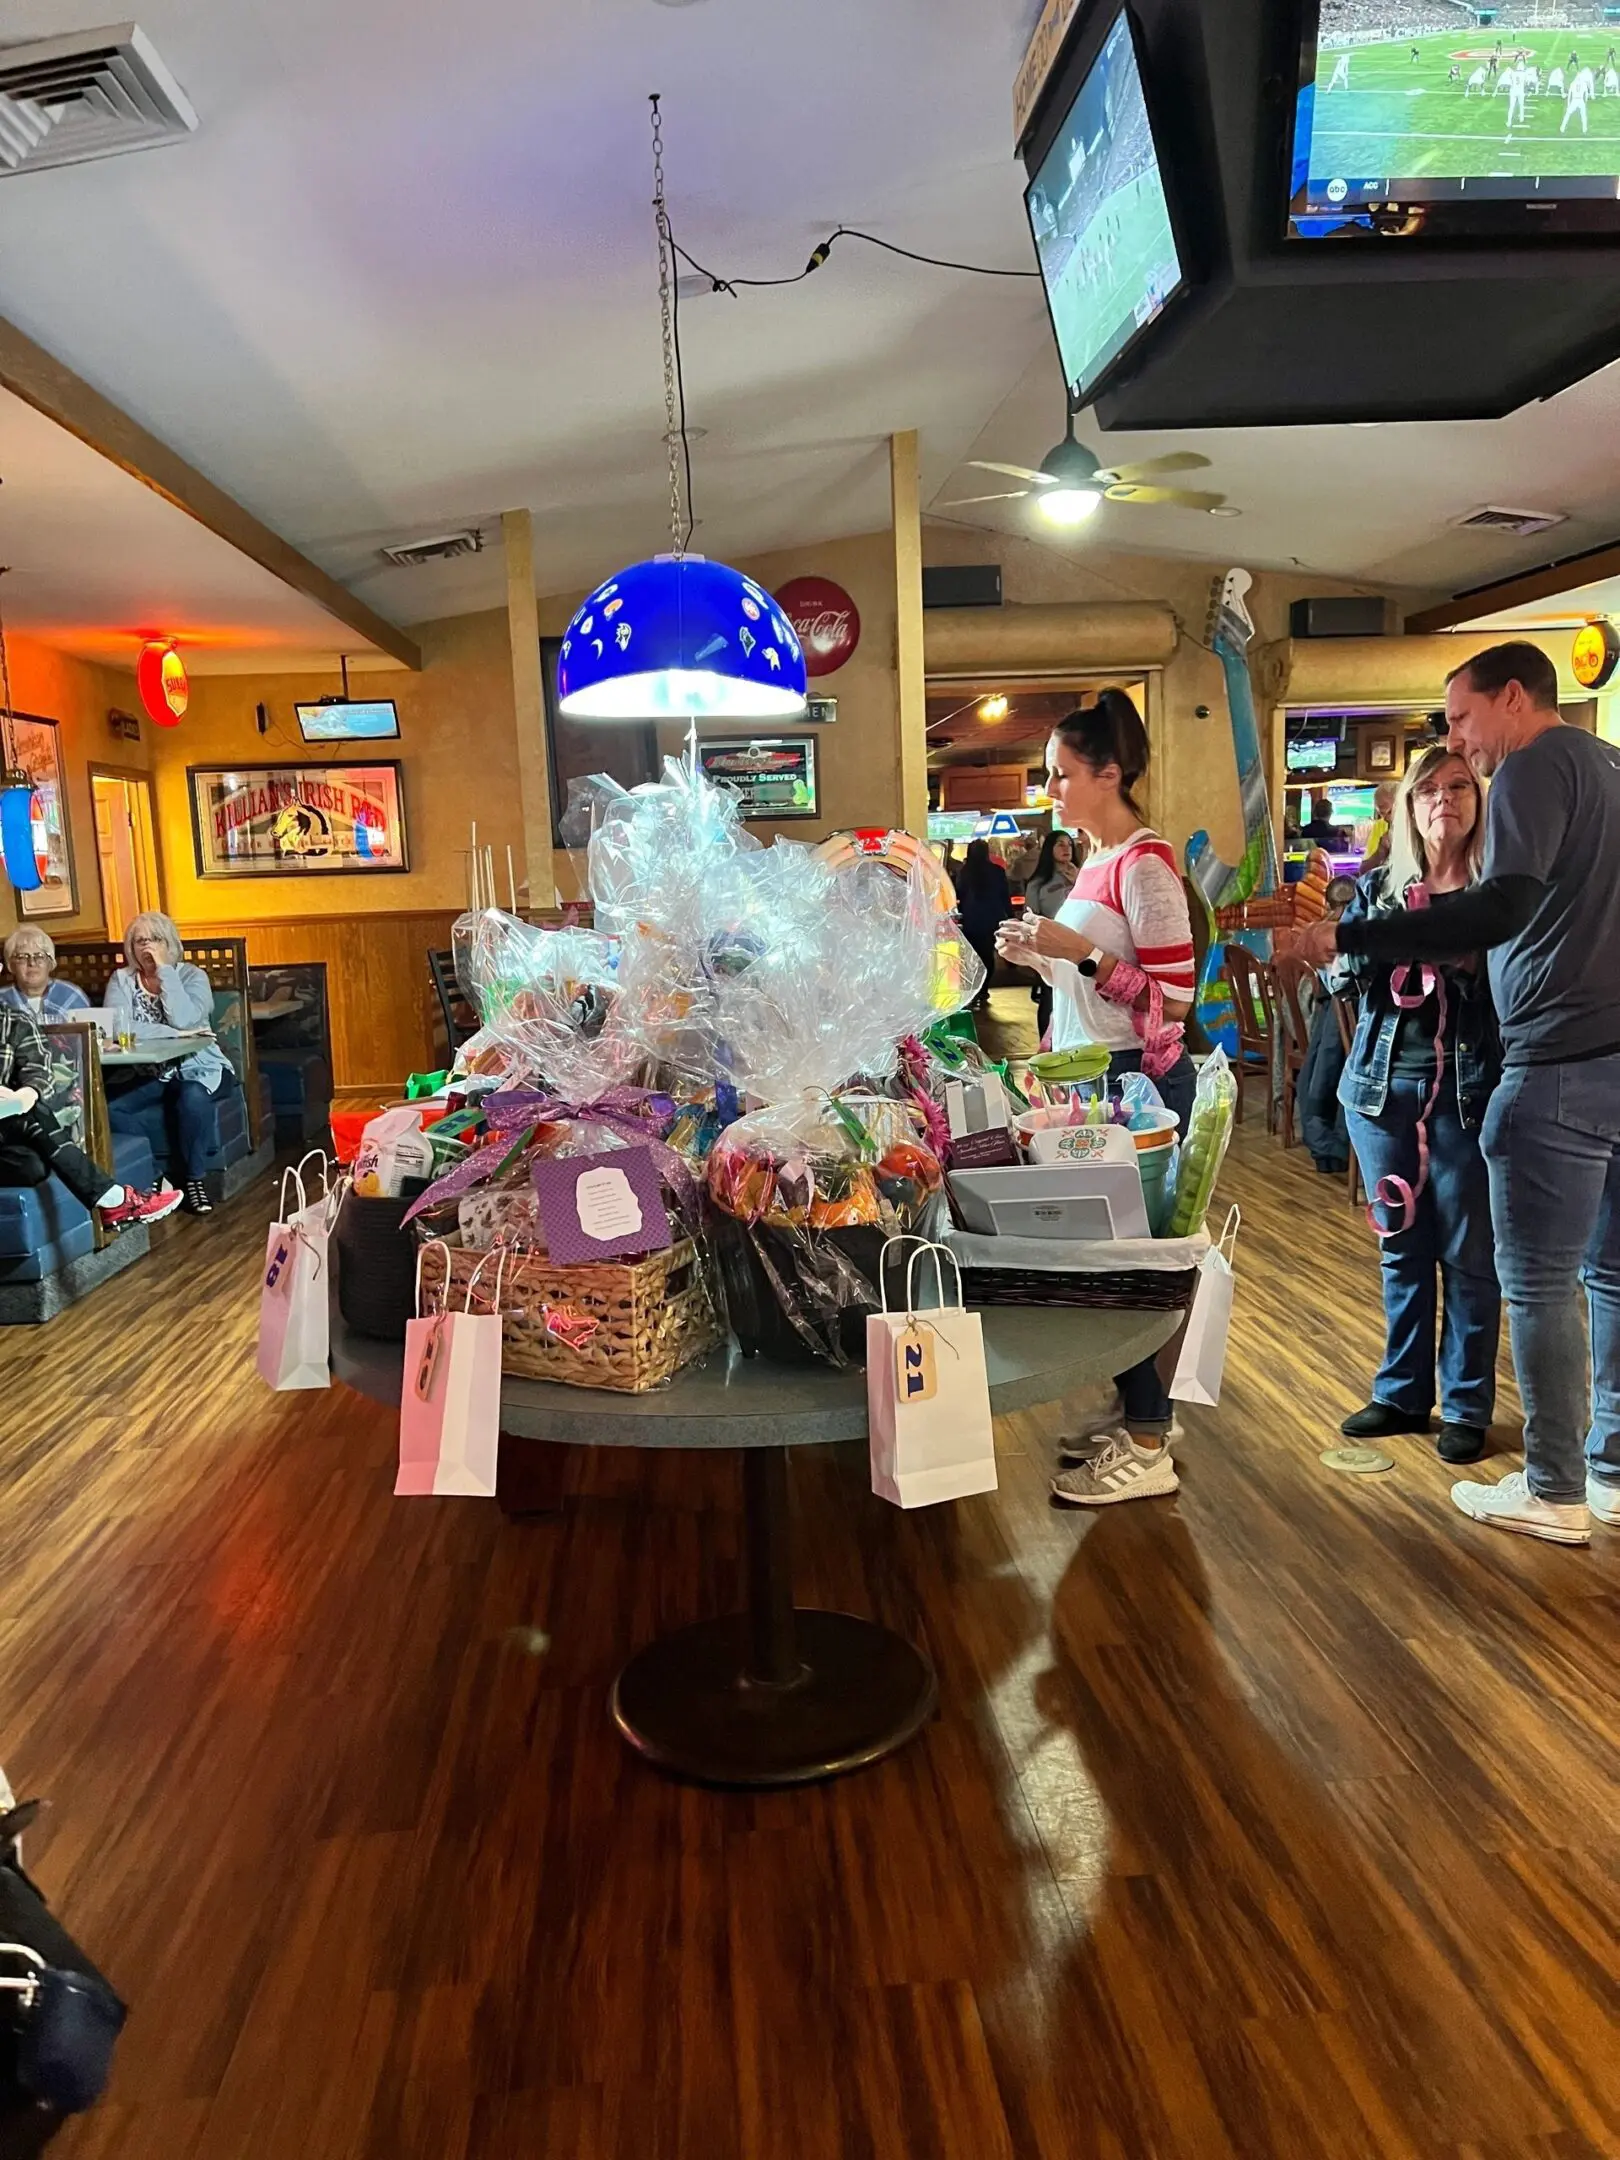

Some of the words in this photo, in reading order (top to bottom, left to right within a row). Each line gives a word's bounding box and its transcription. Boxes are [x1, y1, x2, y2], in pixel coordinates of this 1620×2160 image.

[712, 774, 757, 784] PROUDLY
[759, 773, 797, 782] SERVED
[214, 779, 293, 838] KILLIAN'S
[298, 780, 346, 815] IRISH
[905, 1342, 924, 1398] 21
